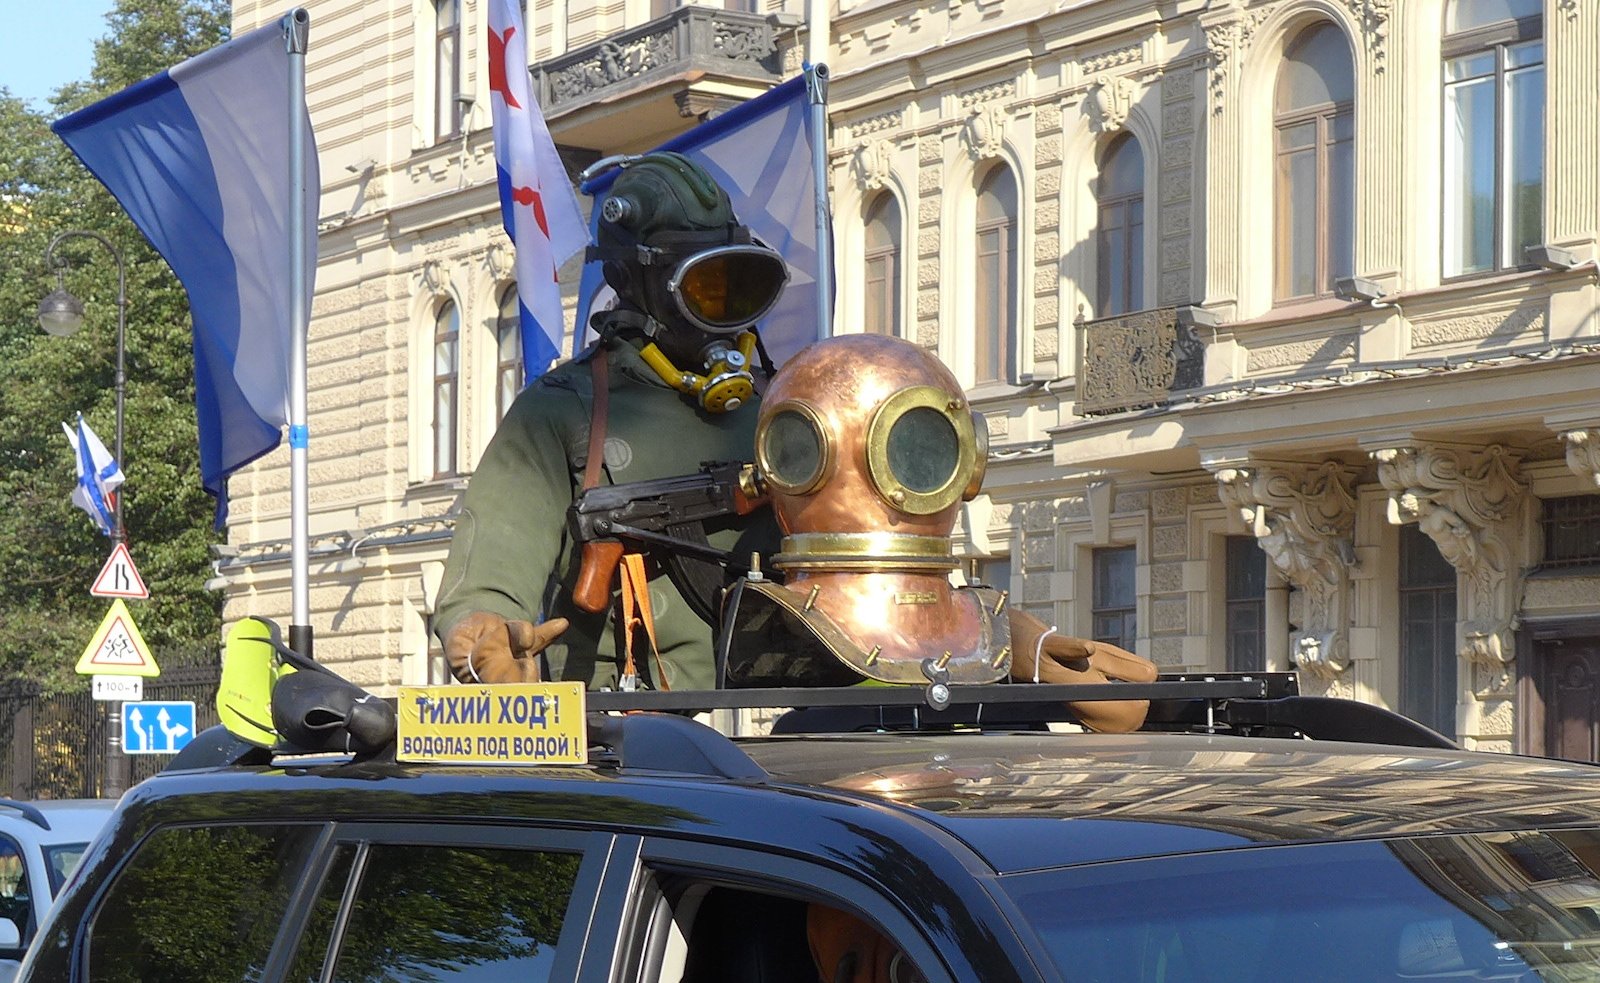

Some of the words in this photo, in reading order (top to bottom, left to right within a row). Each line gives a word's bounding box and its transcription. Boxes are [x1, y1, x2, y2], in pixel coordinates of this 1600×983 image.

[106, 682, 124, 691] 100
[416, 690, 491, 725] ТИХИЙ
[403, 737, 472, 758] ВОДОЛАЗ
[477, 737, 509, 760] ПОД
